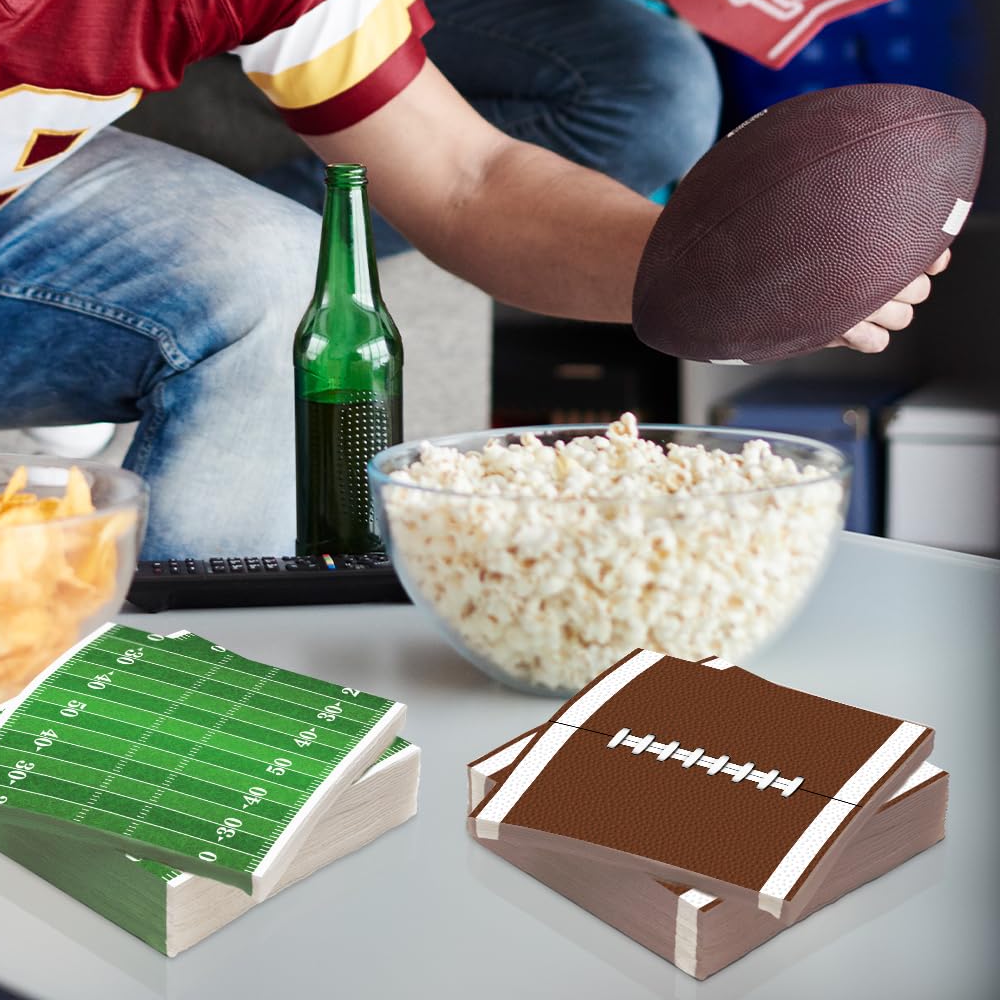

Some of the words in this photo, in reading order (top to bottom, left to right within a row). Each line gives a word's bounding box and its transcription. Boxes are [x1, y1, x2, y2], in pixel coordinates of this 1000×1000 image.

[116, 647, 144, 665] 30
[87, 672, 112, 690] 40
[60, 699, 87, 717] 50
[34, 728, 58, 747] 40
[8, 760, 35, 780] 30
[216, 817, 243, 839] 30
[243, 786, 268, 806] 40
[265, 758, 292, 776] 50
[293, 730, 317, 748] 40
[316, 704, 343, 722] 30
